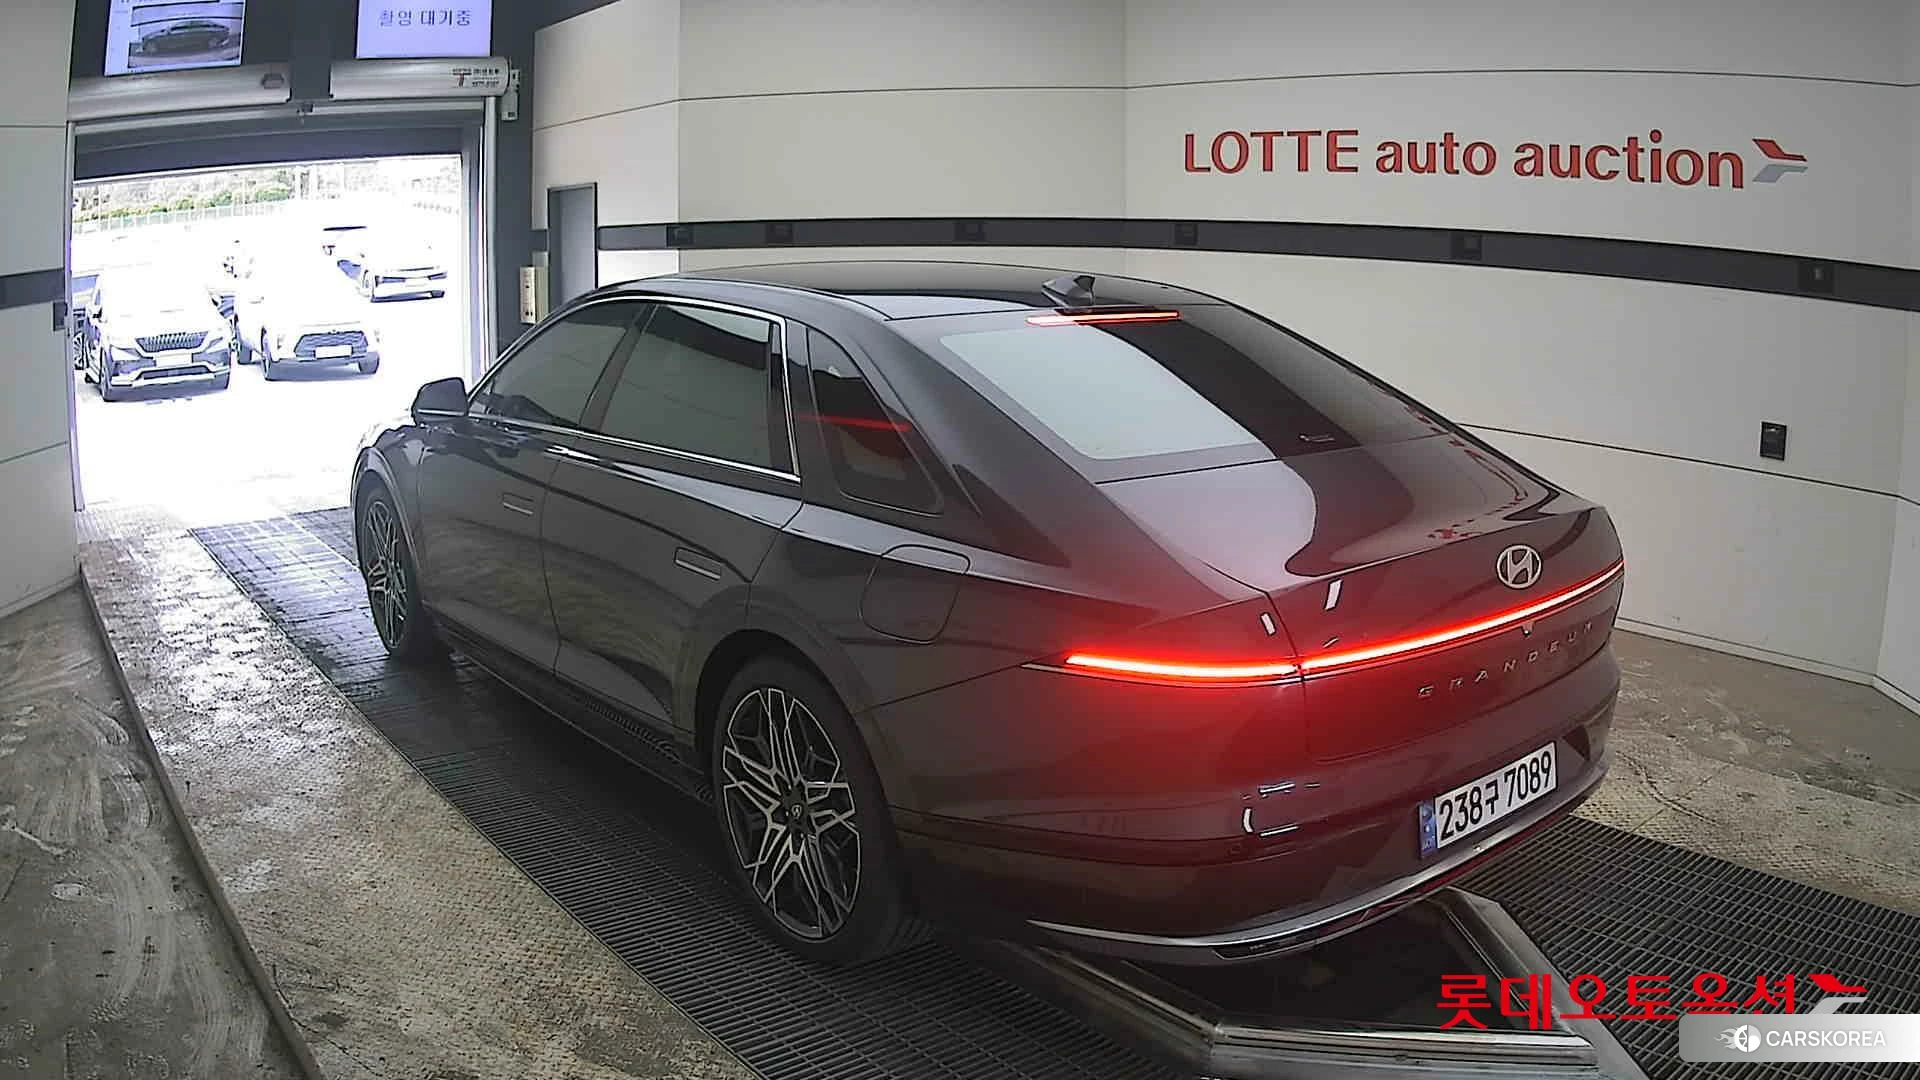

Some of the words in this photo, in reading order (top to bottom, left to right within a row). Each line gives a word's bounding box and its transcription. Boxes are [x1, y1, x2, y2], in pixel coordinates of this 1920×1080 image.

[420, 9, 470, 26] 대기중
[1184, 129, 1358, 174] LOTTE
[1376, 132, 1497, 176] auto
[1513, 129, 1744, 189] auction
[1418, 620, 1593, 697] GRANDEUR
[1439, 779, 1499, 841] 238구
[1504, 751, 1551, 807] 7089
